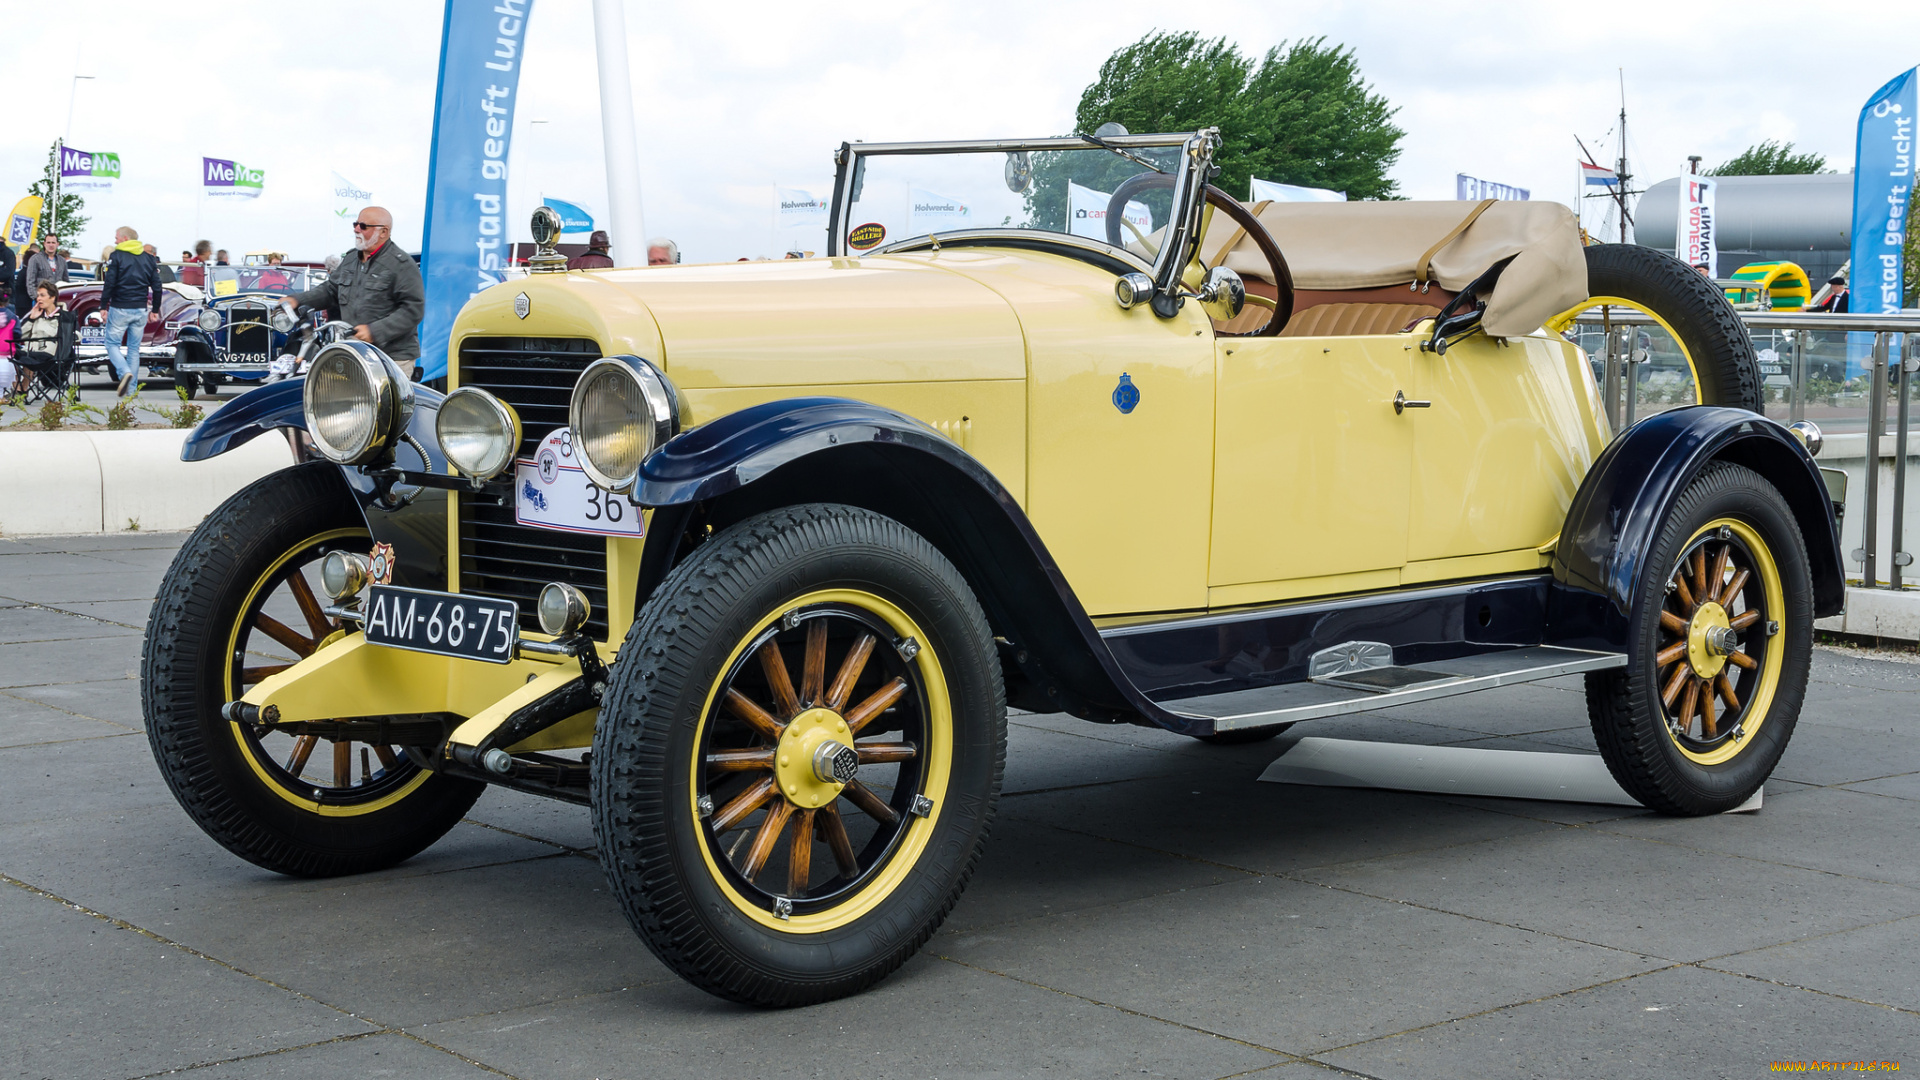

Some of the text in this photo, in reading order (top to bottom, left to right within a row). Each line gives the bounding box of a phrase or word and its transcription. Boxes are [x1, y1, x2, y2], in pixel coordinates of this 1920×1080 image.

[481, 84, 510, 180] geeft
[1889, 116, 1912, 178] lucht
[64, 151, 120, 172] MeMo
[208, 162, 263, 183] MeMo
[335, 186, 373, 201] valspar
[781, 201, 818, 209] Holwerda
[914, 203, 955, 212] Holwerda
[1884, 185, 1907, 246] geeft
[585, 482, 623, 523] 36
[368, 594, 511, 653] AM-68-75
[841, 748, 858, 776] ESSEX
[865, 791, 984, 954] MICHELIN
